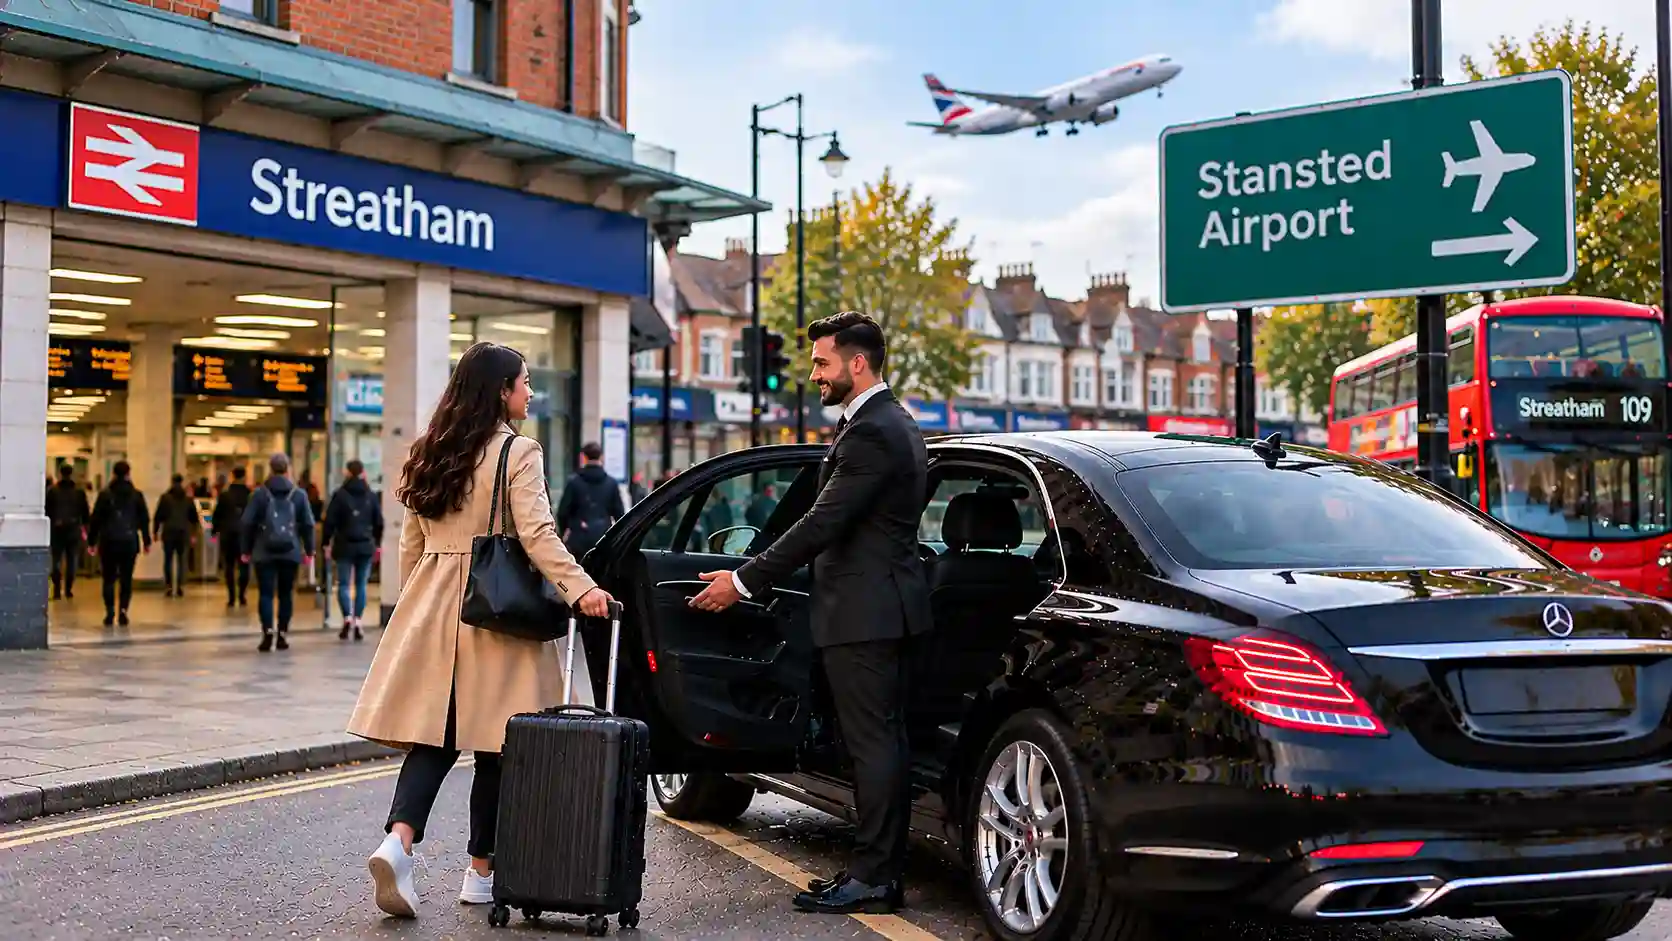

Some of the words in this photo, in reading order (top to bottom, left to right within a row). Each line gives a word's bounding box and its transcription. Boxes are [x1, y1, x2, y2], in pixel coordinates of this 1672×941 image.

[1198, 139, 1391, 198] Stansted
[250, 158, 494, 251] Streatham
[1199, 197, 1355, 252] Airport
[1519, 397, 1605, 417] Streatham
[1620, 396, 1652, 423] 109
